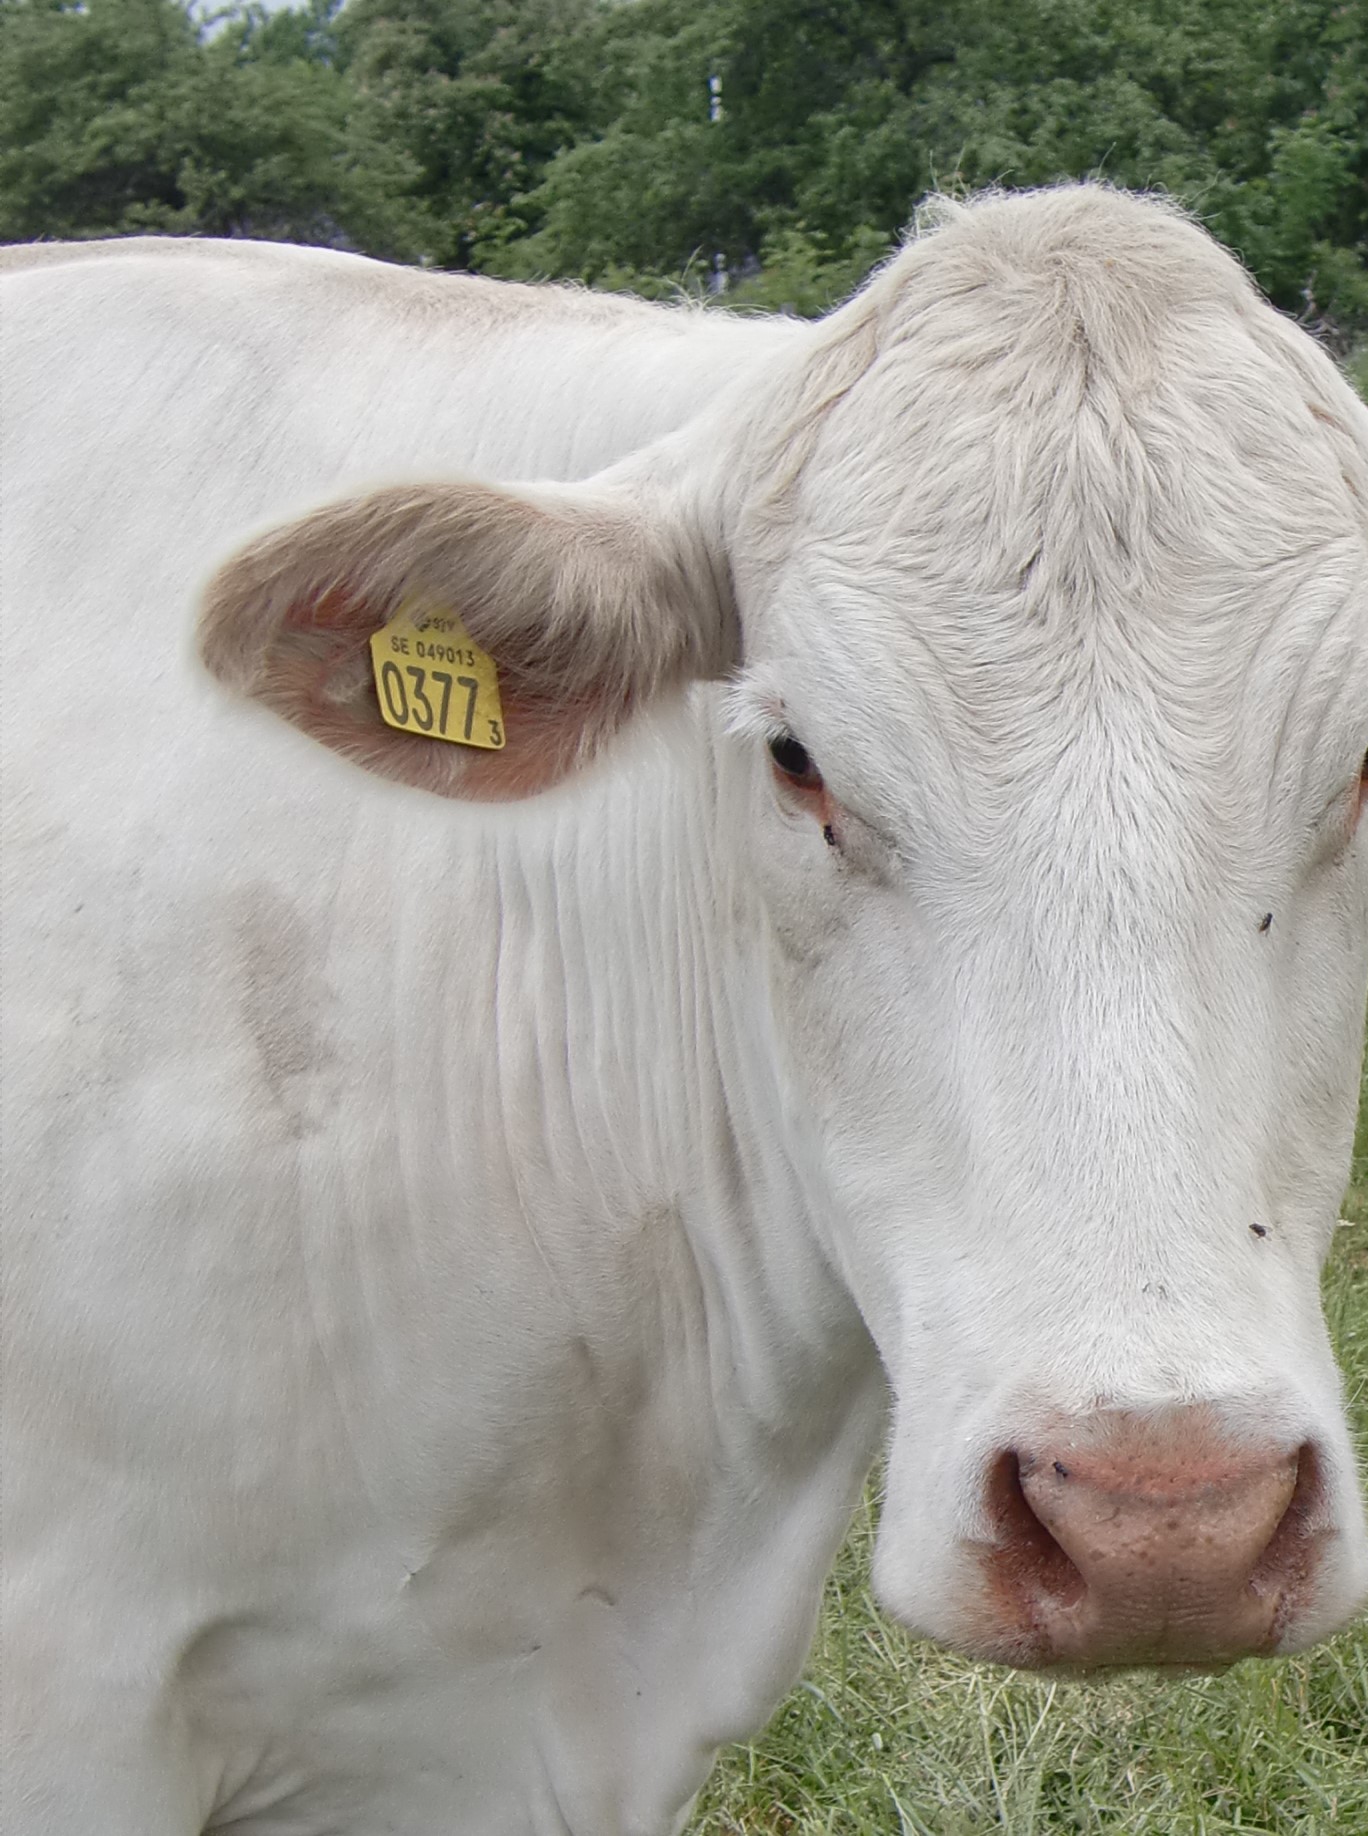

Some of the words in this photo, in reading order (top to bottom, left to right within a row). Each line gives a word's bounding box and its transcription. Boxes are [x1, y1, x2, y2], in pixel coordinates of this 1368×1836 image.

[391, 636, 410, 655] SE
[416, 641, 475, 667] 049013
[382, 661, 479, 740] 0377
[488, 720, 503, 746] 3
